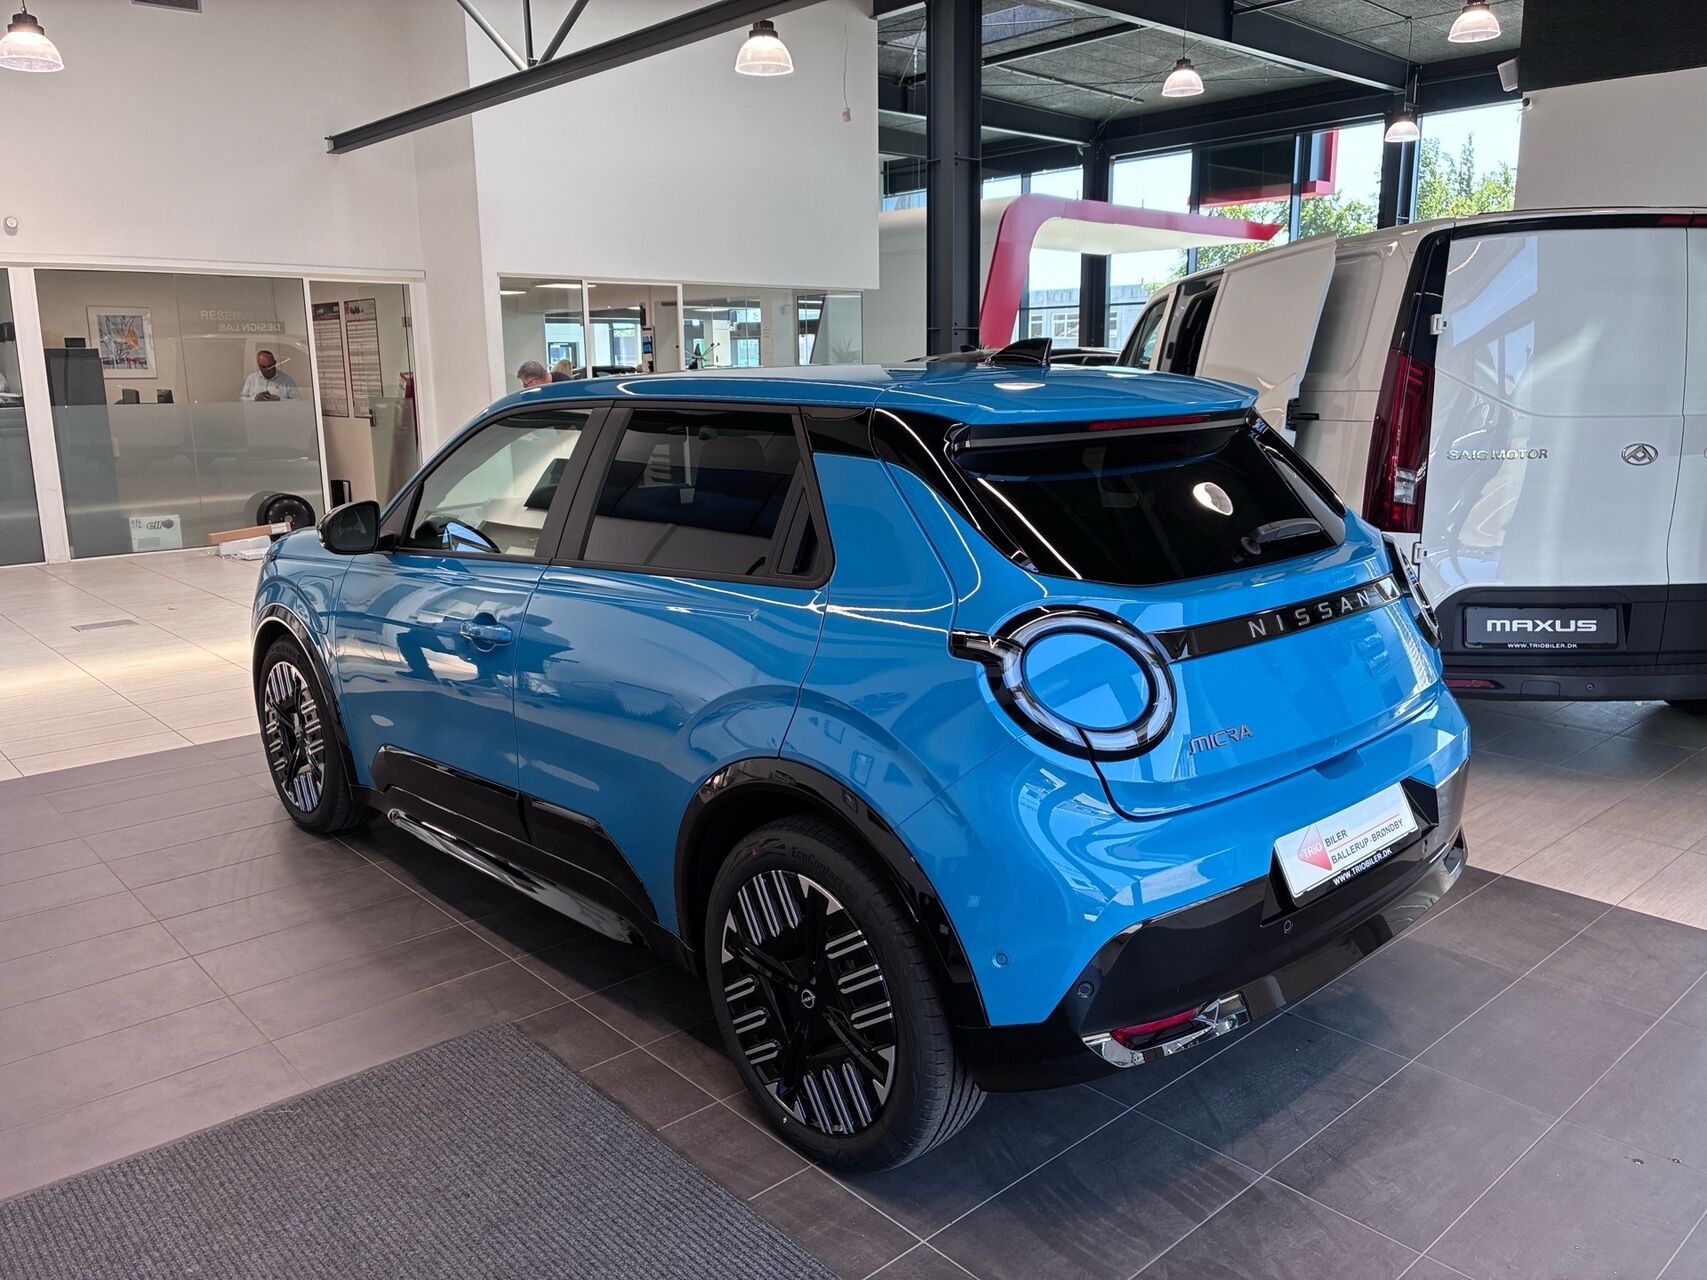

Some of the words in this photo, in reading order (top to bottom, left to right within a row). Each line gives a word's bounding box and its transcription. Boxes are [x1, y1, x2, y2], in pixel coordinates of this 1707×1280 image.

[1446, 449, 1489, 461] SAIC
[1491, 449, 1549, 460] MOTOR
[1248, 589, 1370, 639] NISSAN
[1486, 620, 1597, 632] MAXUS
[1188, 723, 1254, 756] MICRA
[1325, 829, 1348, 847] BILER
[1302, 842, 1322, 859] TRIO
[1331, 838, 1369, 864] BALLERUP
[1333, 847, 1393, 886] WWW.TRIOBILER.DK
